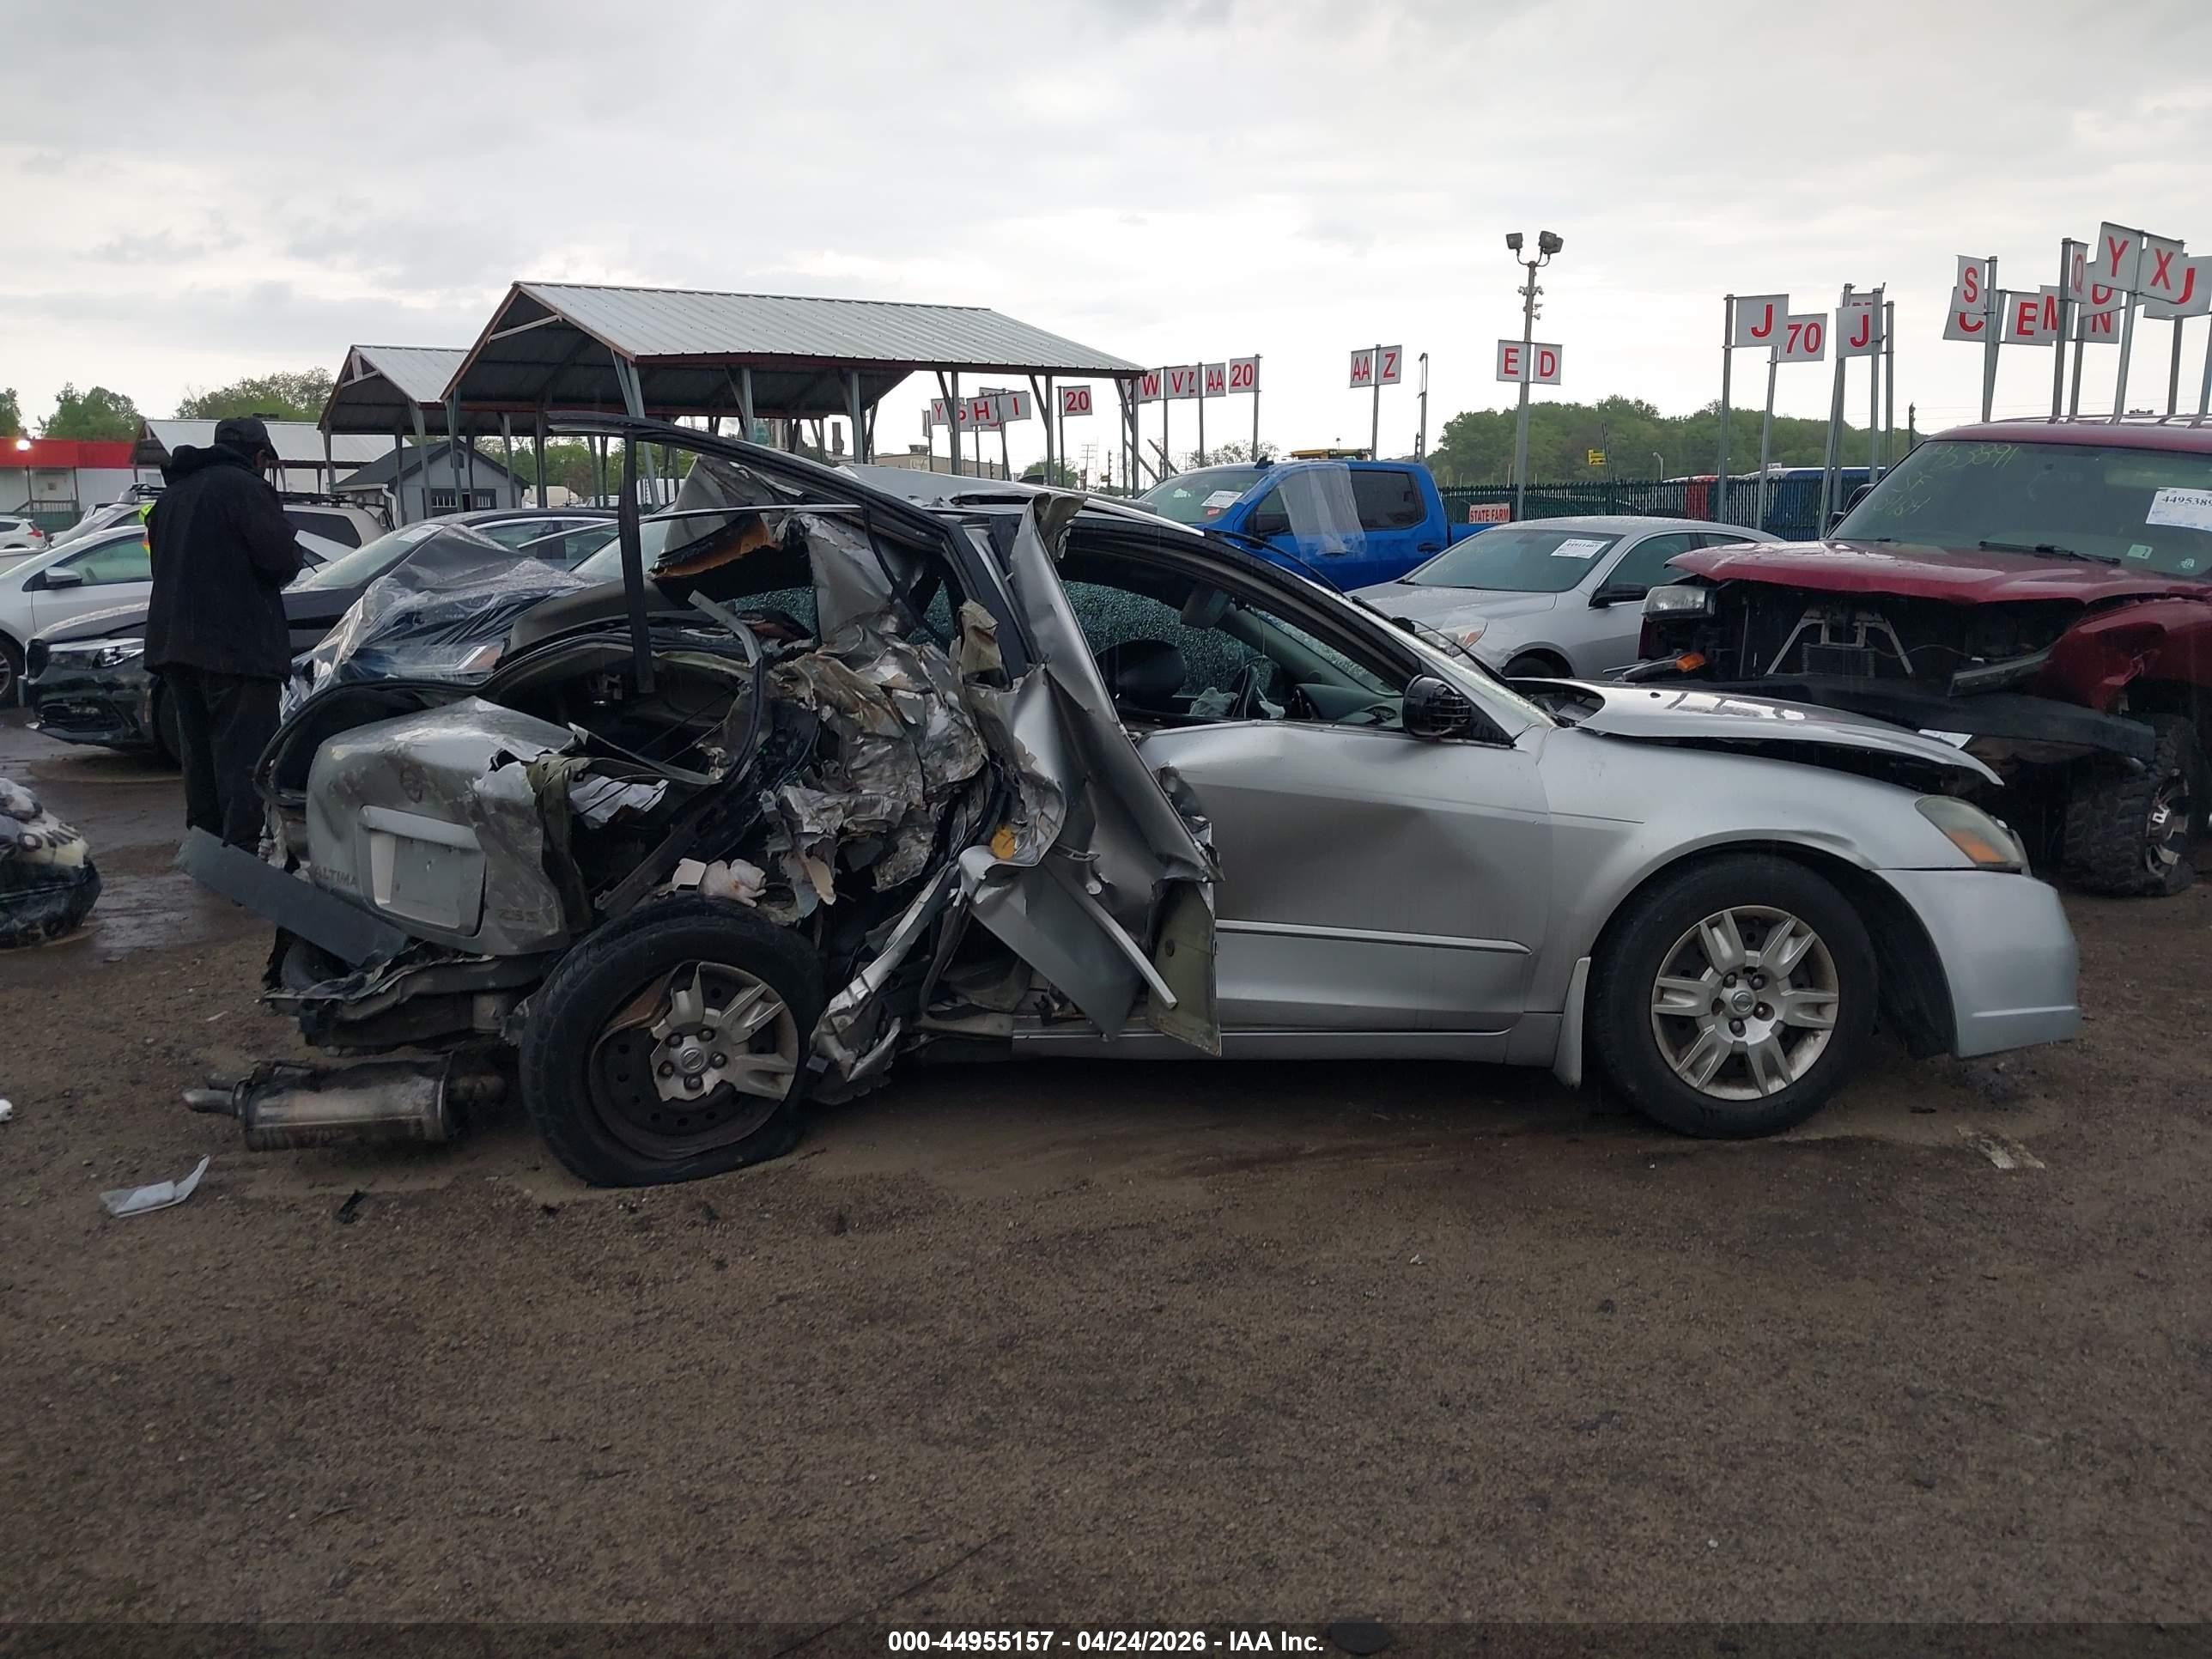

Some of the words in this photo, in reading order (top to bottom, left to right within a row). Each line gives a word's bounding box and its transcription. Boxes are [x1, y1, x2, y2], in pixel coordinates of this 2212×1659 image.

[2107, 235, 2130, 278] Y
[2149, 247, 2175, 291] X
[1963, 266, 1978, 303] S
[2074, 253, 2084, 295] Q
[1750, 303, 1773, 338] J
[1850, 314, 1869, 348] J
[2016, 301, 2039, 336] E
[1786, 322, 1822, 355] 70
[1352, 356, 1370, 382] AA
[1382, 352, 1396, 379] Z
[1504, 347, 1519, 375] E
[1539, 350, 1556, 378] D
[1142, 374, 1159, 397] W
[1170, 371, 1184, 393] V
[1206, 369, 1224, 392] AA
[1231, 363, 1253, 387] 20
[933, 402, 944, 421] Y
[973, 400, 990, 422] H
[1012, 397, 1019, 416] I
[1066, 391, 1090, 411] 20
[1469, 509, 1490, 522] STATE
[1491, 507, 1509, 522] FARM
[313, 865, 358, 888] ALTIMA
